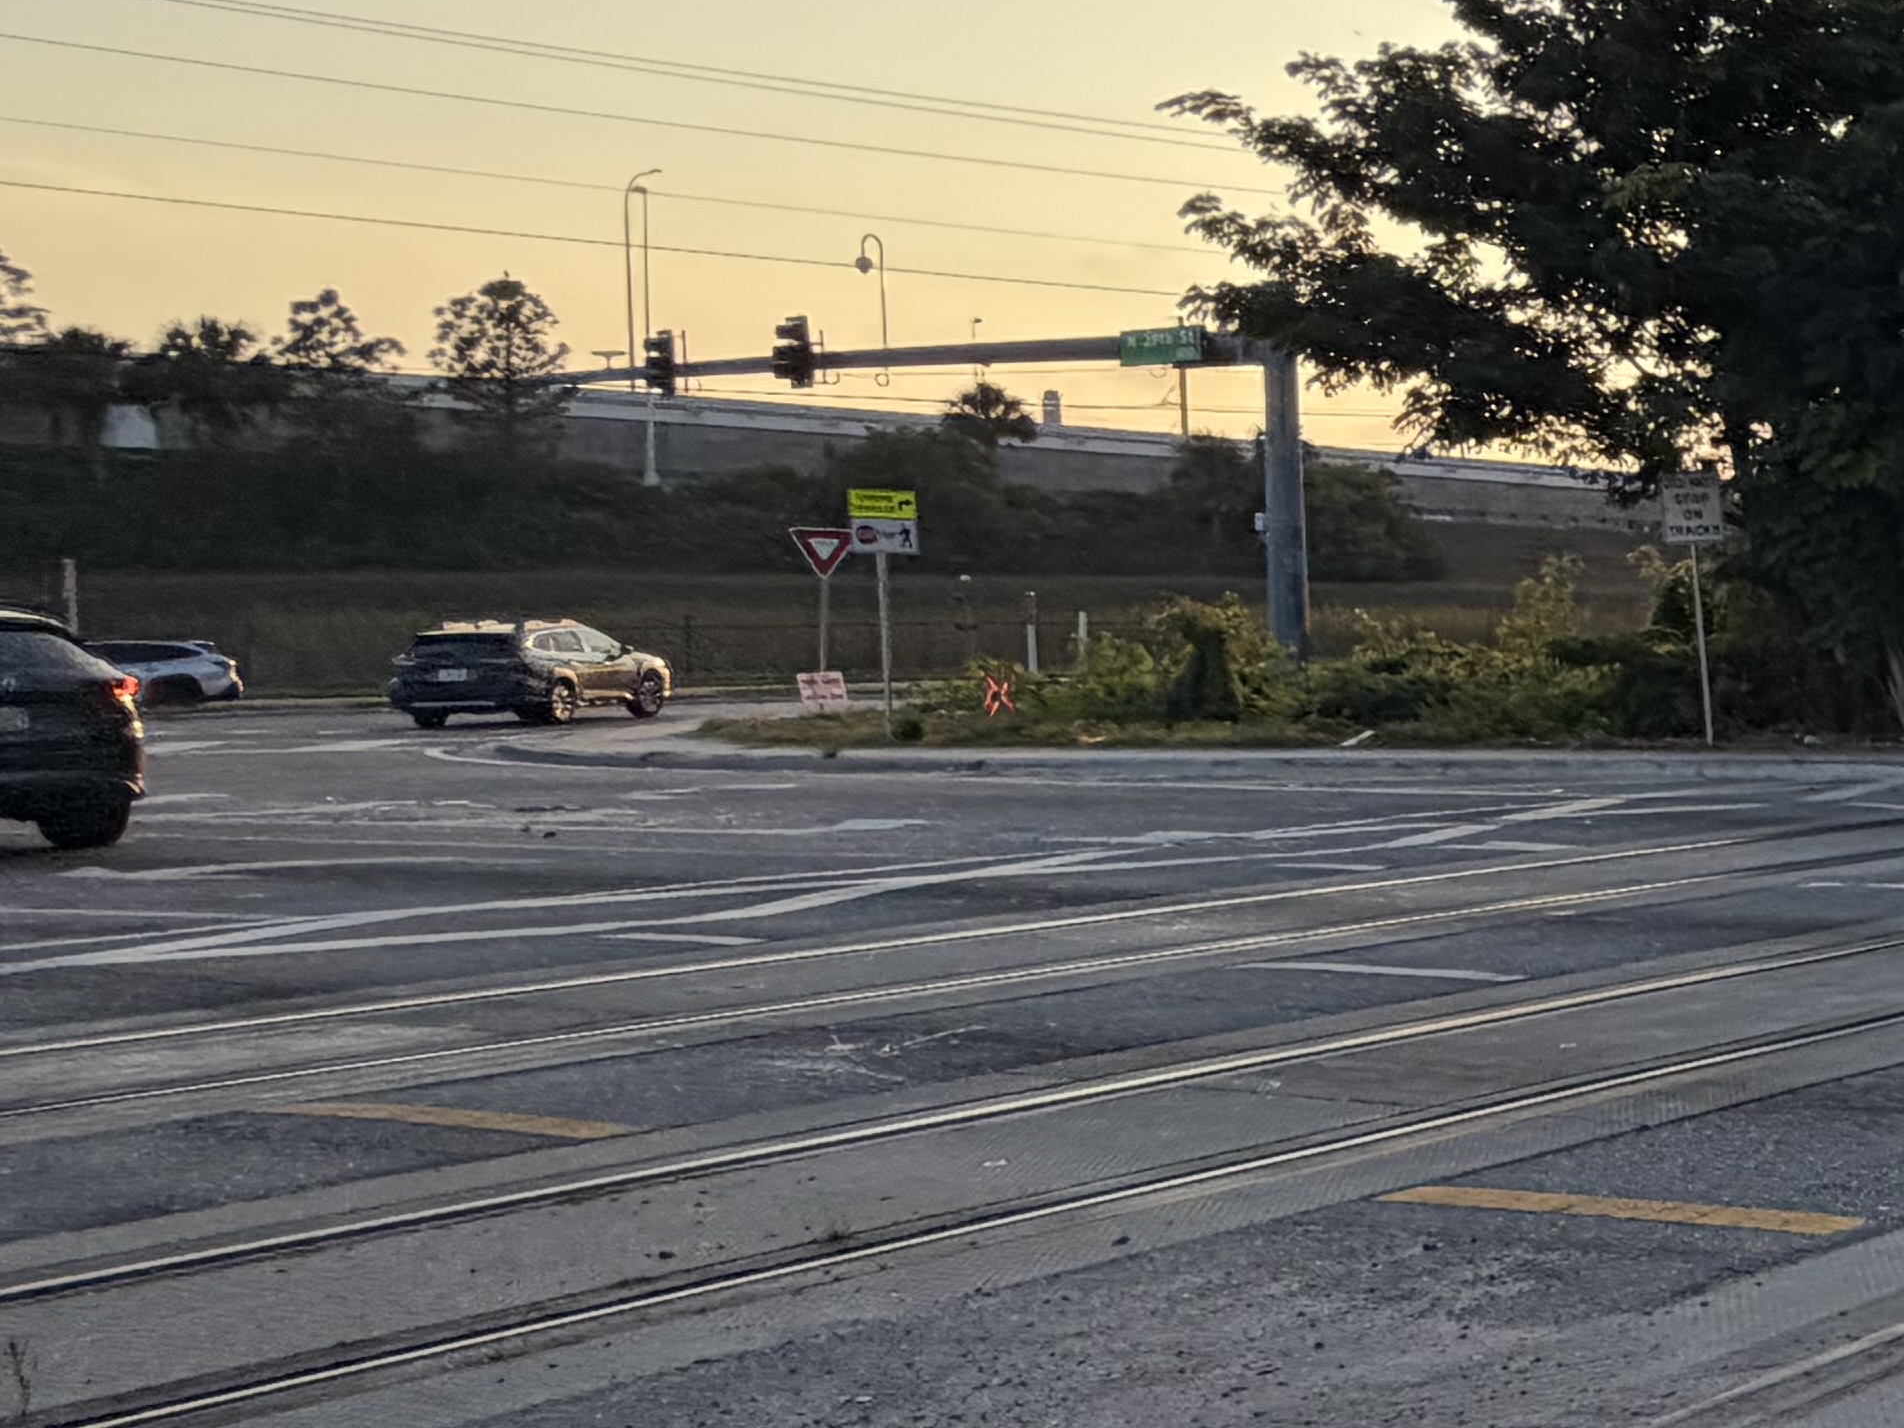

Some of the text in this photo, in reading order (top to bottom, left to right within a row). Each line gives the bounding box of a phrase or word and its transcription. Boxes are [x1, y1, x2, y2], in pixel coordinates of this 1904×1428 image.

[1674, 492, 1710, 506] STOP
[1683, 508, 1703, 521] ON
[1669, 523, 1720, 537] TRACKS
